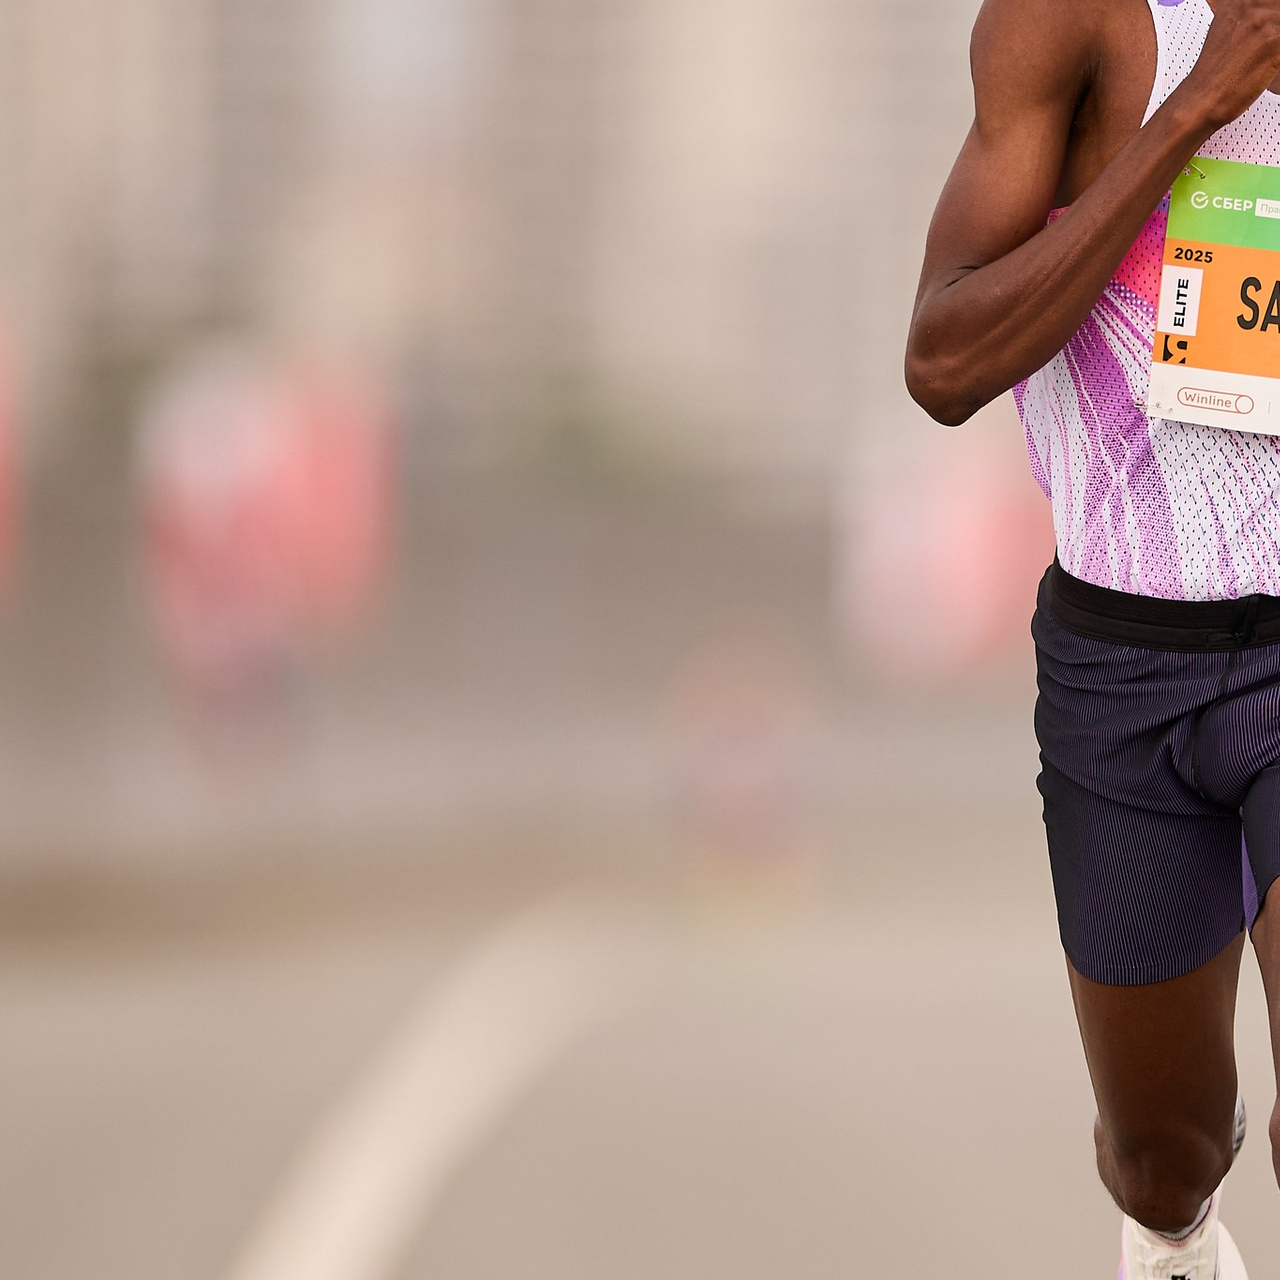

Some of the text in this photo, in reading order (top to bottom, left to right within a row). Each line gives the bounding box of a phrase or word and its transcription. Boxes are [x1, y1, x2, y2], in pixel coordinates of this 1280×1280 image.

[1212, 196, 1253, 211] СБЕР
[1174, 247, 1213, 263] 2025
[1173, 278, 1190, 327] ELITE
[1184, 391, 1232, 408] Winline
